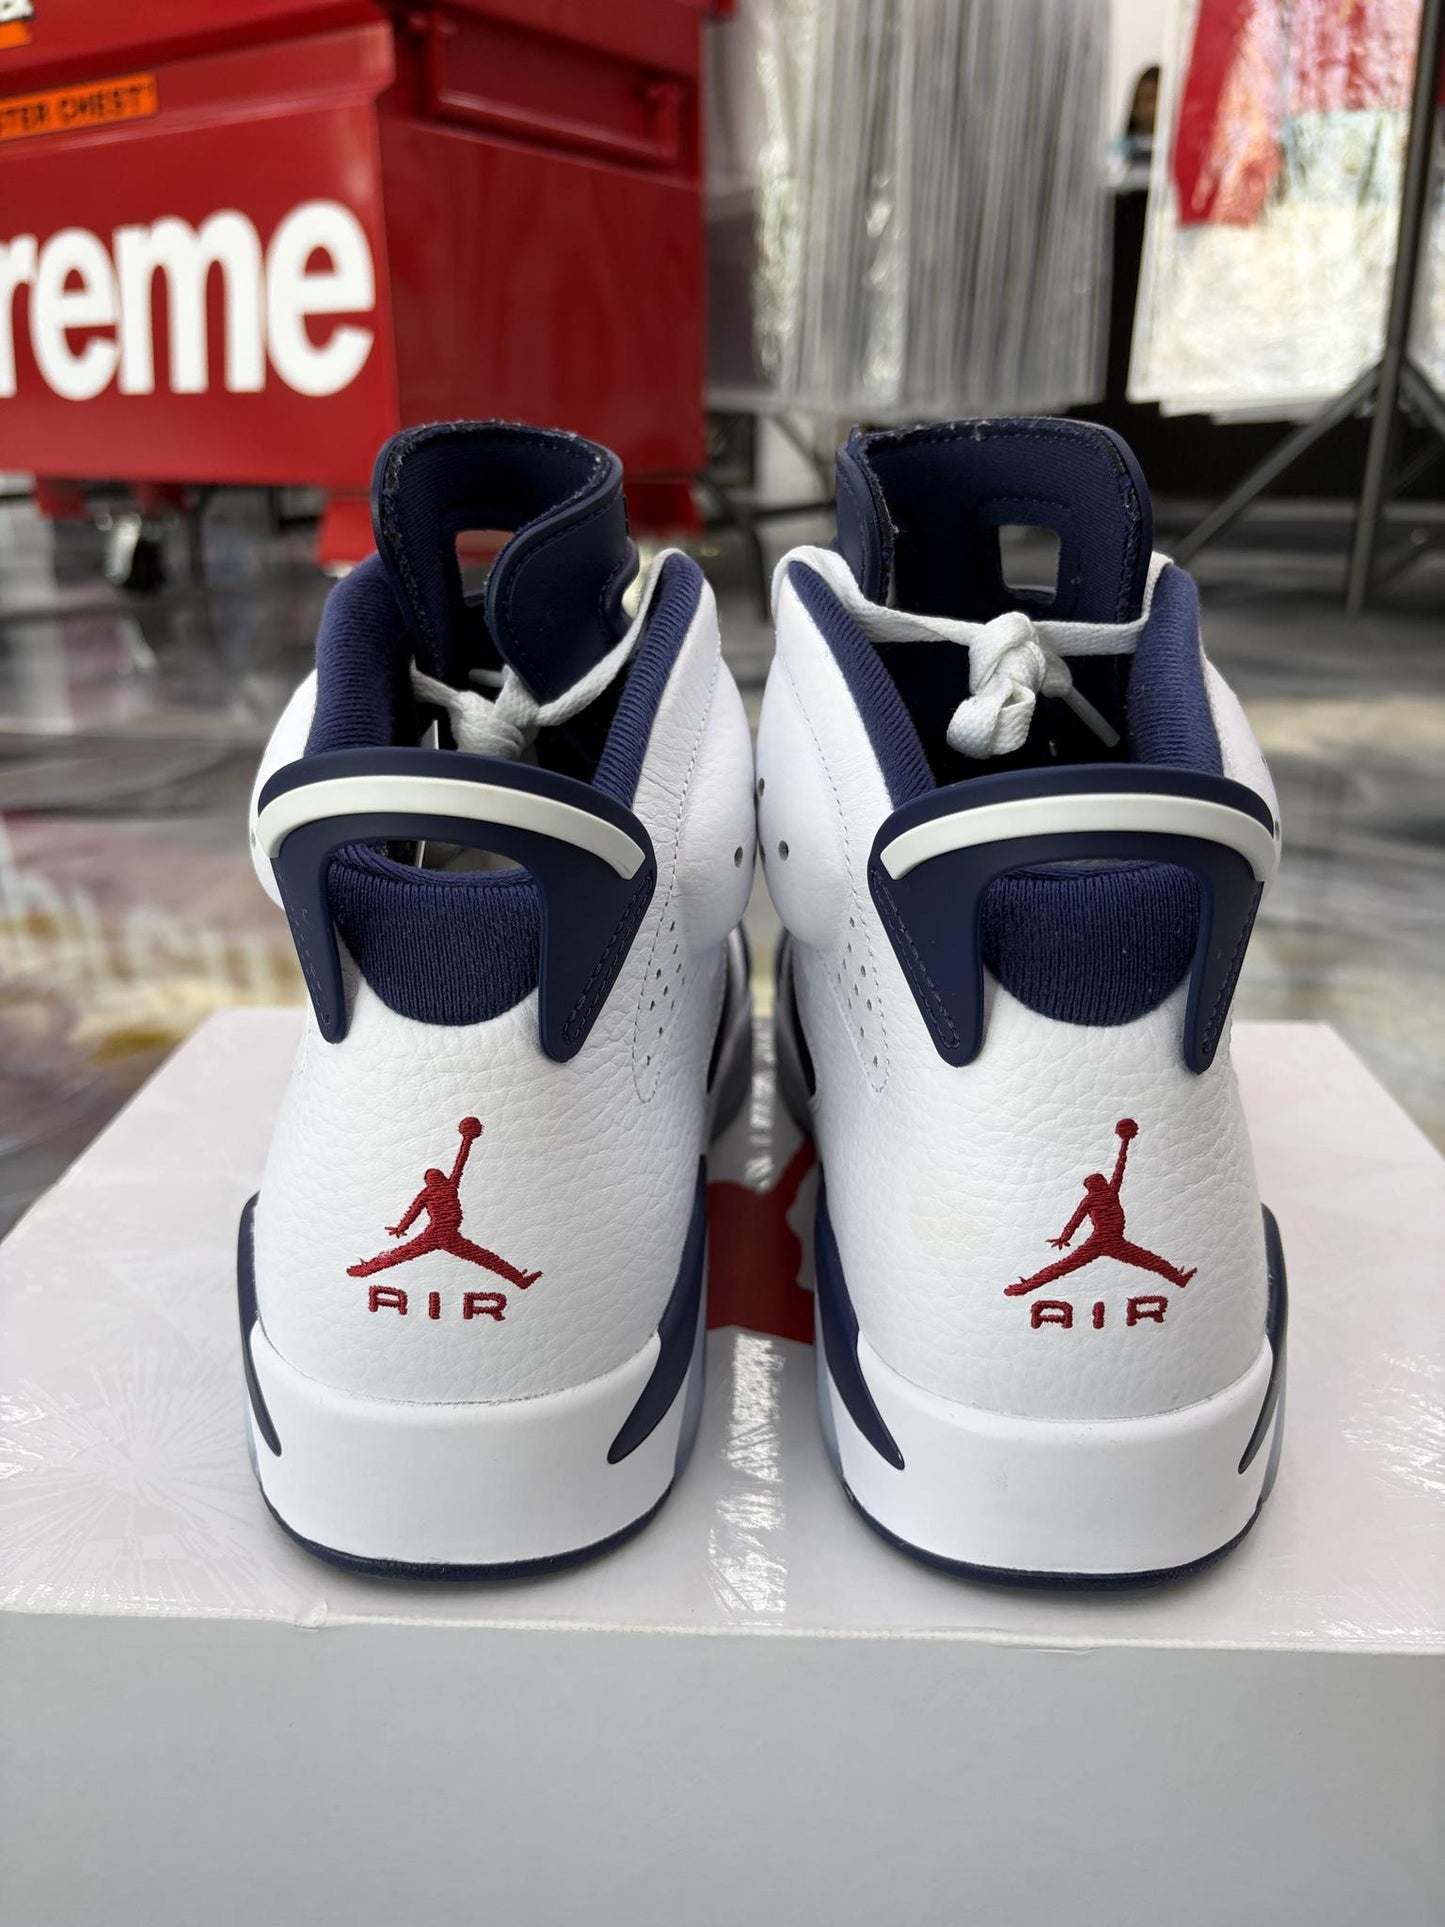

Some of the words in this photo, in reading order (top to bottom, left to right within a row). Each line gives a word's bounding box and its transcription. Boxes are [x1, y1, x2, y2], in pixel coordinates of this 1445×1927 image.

[57, 81, 147, 124] CHEST
[0, 200, 375, 400] reme
[368, 1285, 507, 1321] AIR
[1030, 1296, 1168, 1329] AIR
